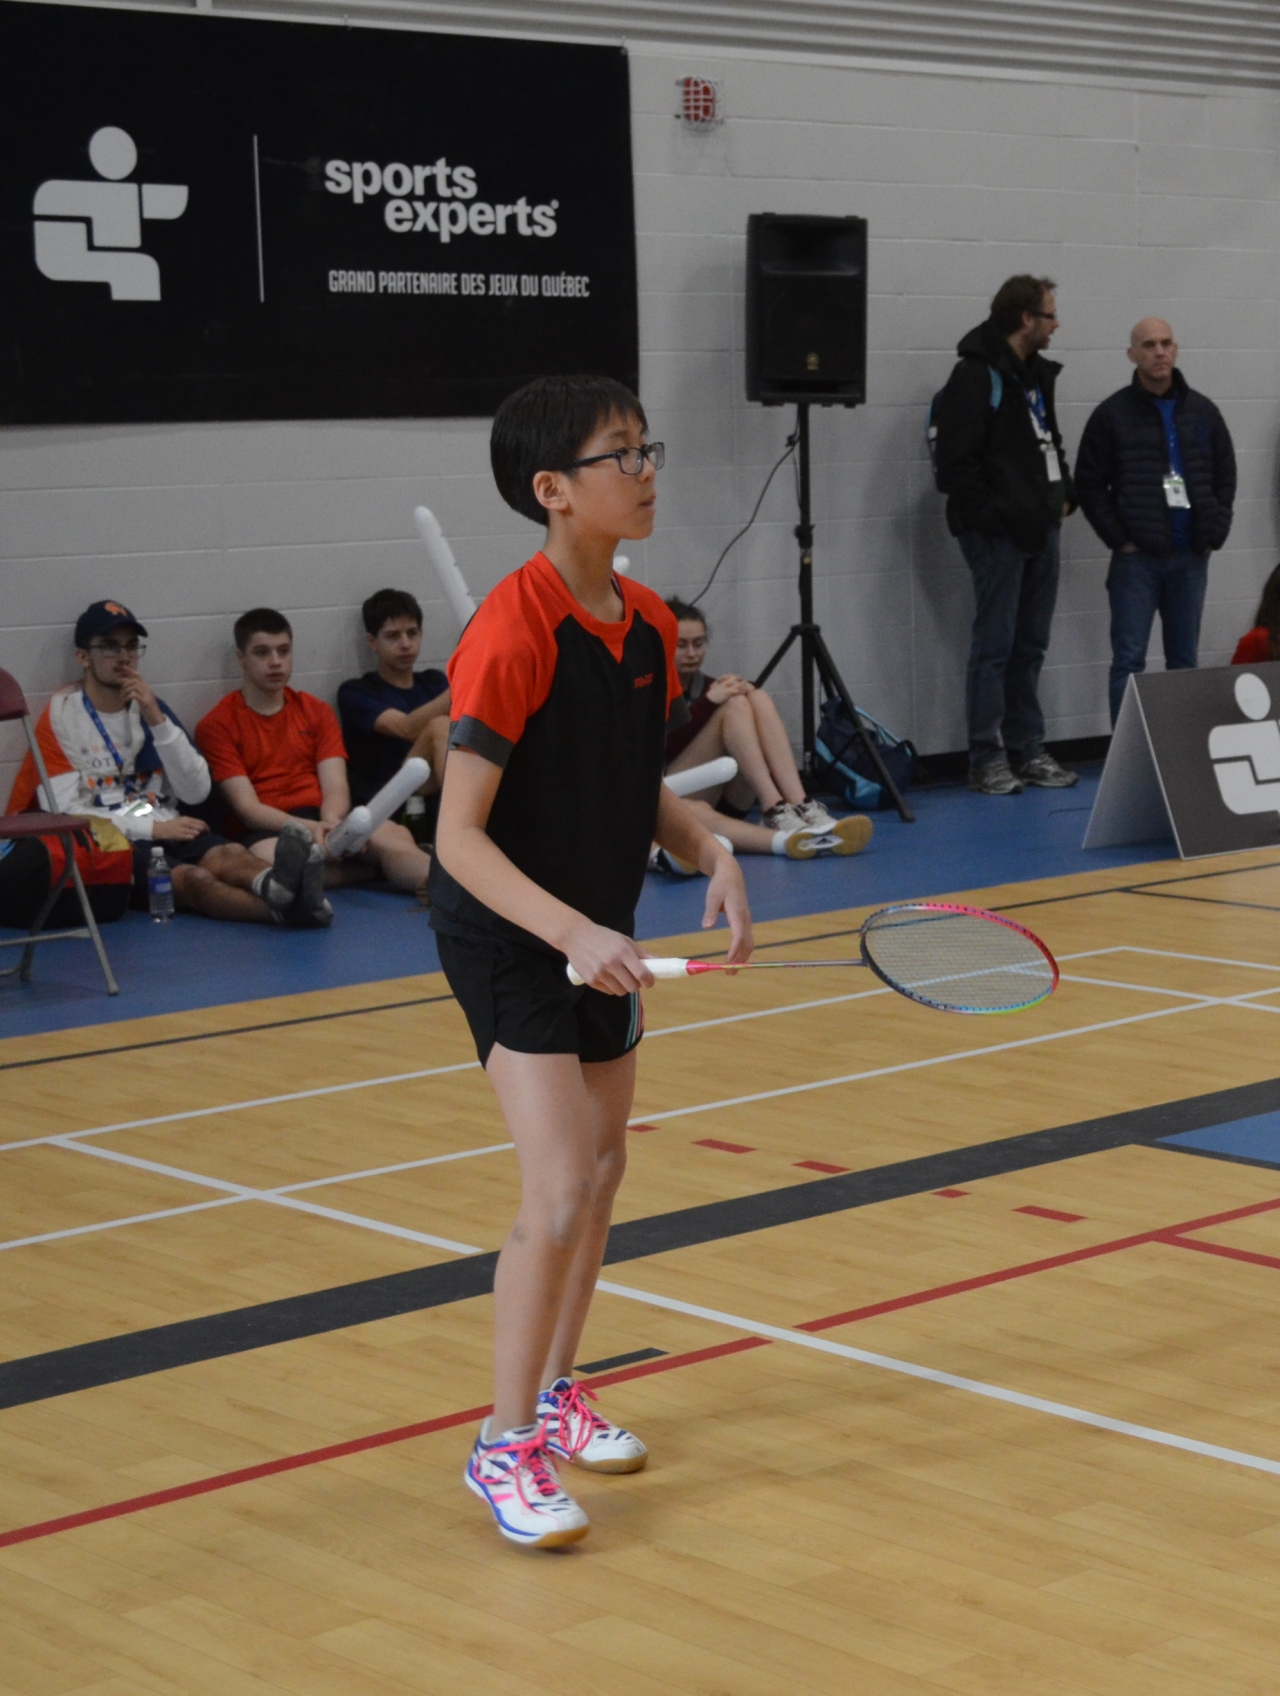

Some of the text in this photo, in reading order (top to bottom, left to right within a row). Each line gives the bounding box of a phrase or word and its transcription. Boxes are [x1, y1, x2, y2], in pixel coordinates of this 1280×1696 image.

[324, 157, 478, 203] sports
[384, 197, 558, 243] experts
[328, 269, 590, 297] GRAND PARTENAIRE DES JEUX DU QUÉBEC
